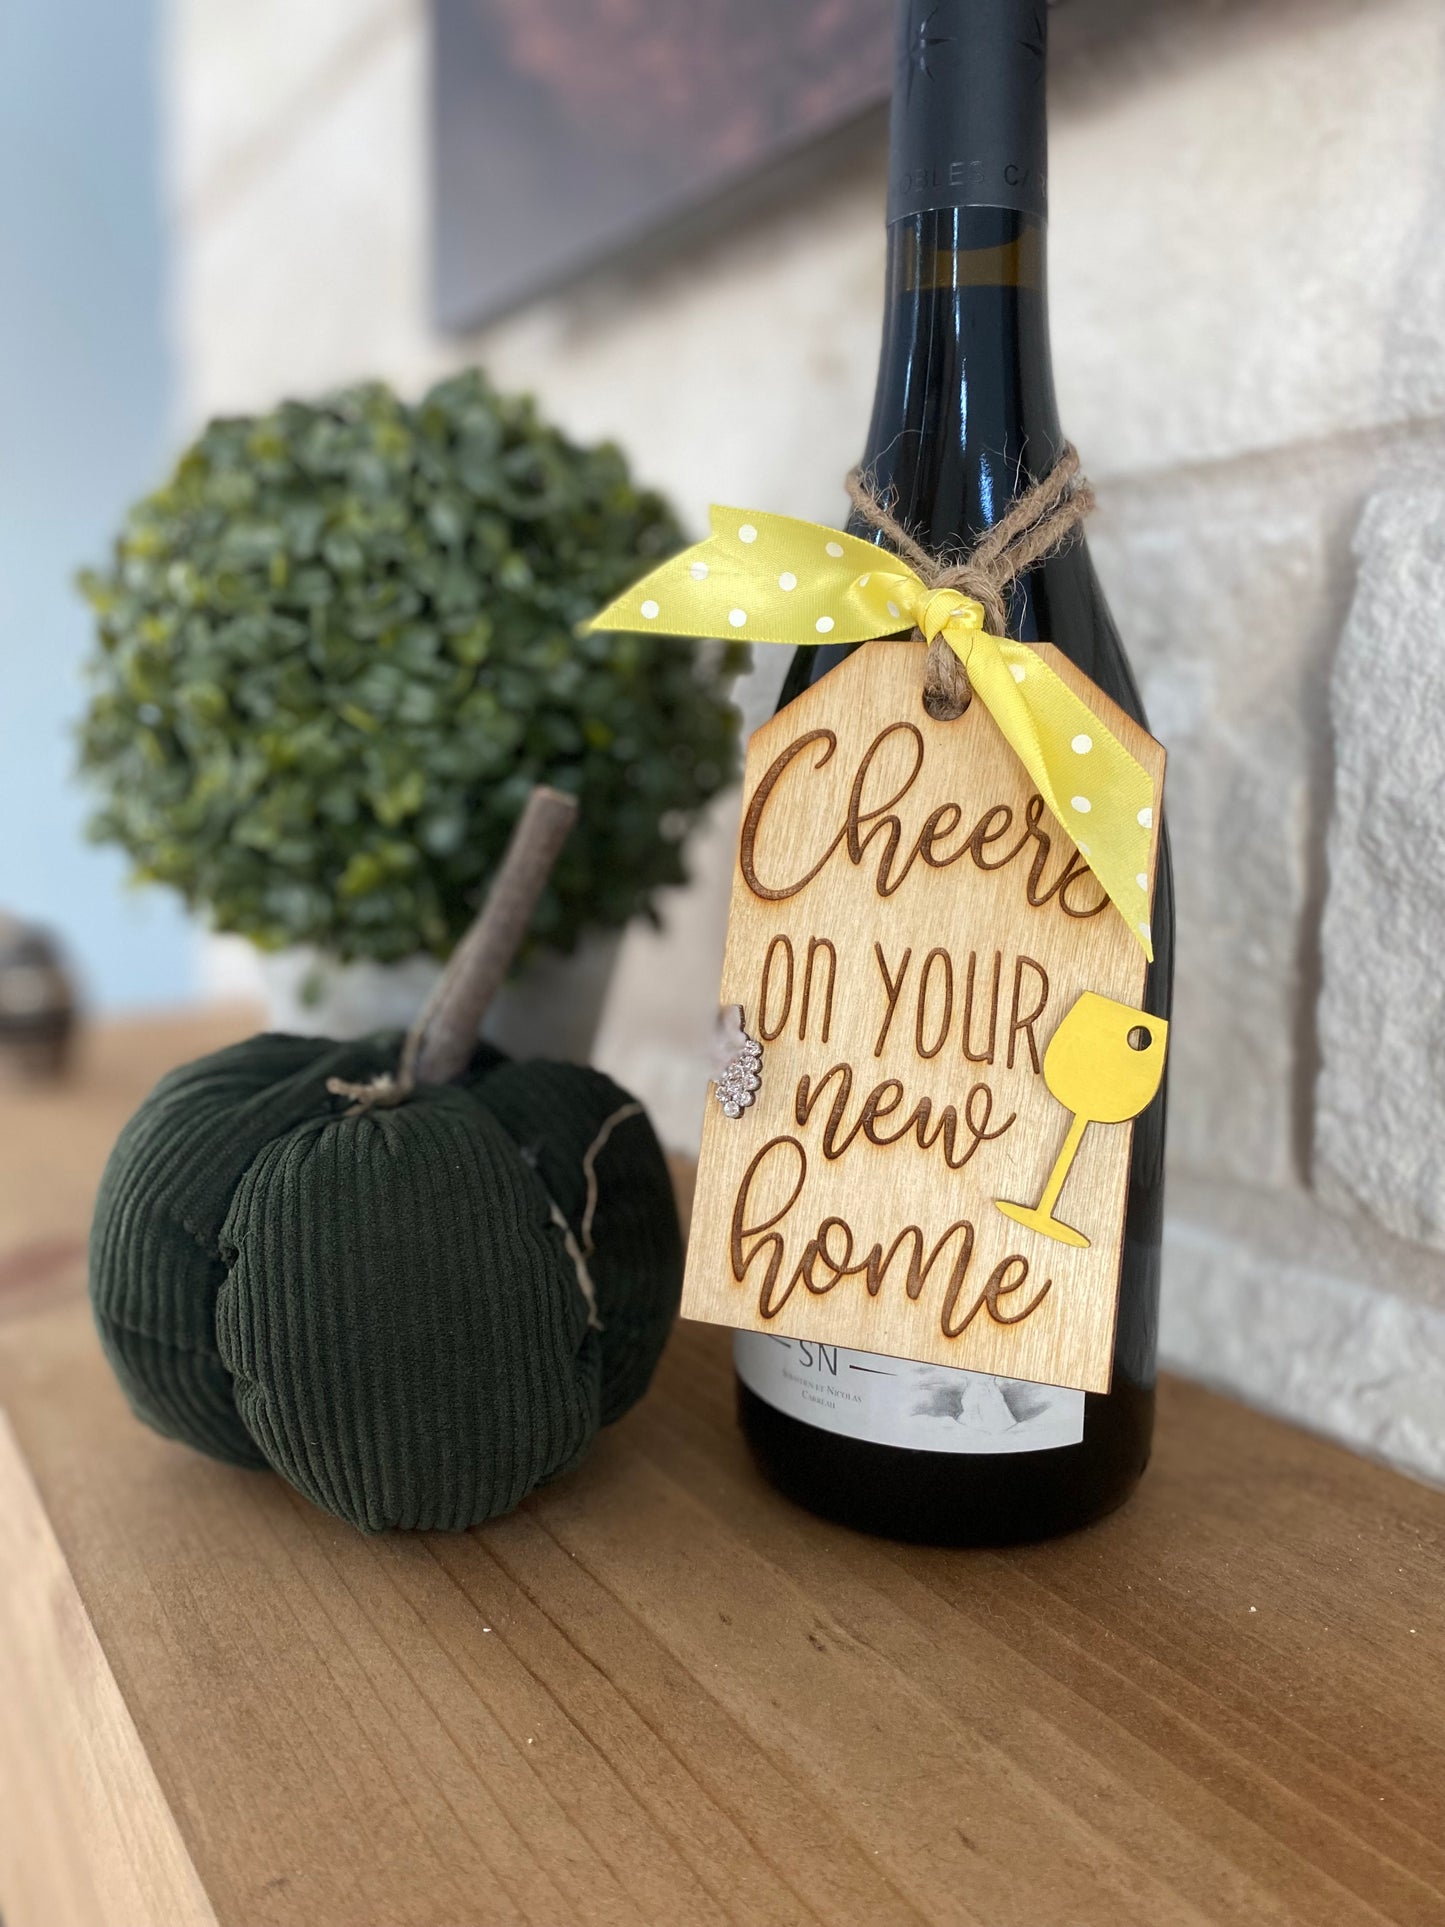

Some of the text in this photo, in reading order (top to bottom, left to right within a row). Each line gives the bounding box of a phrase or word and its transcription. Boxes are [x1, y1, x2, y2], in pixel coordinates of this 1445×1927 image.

[901, 161, 985, 196] OBLES
[874, 941, 1050, 1074] YOUR
[795, 1063, 1017, 1170] new
[731, 1135, 1052, 1338] home
[799, 1340, 837, 1376] SN
